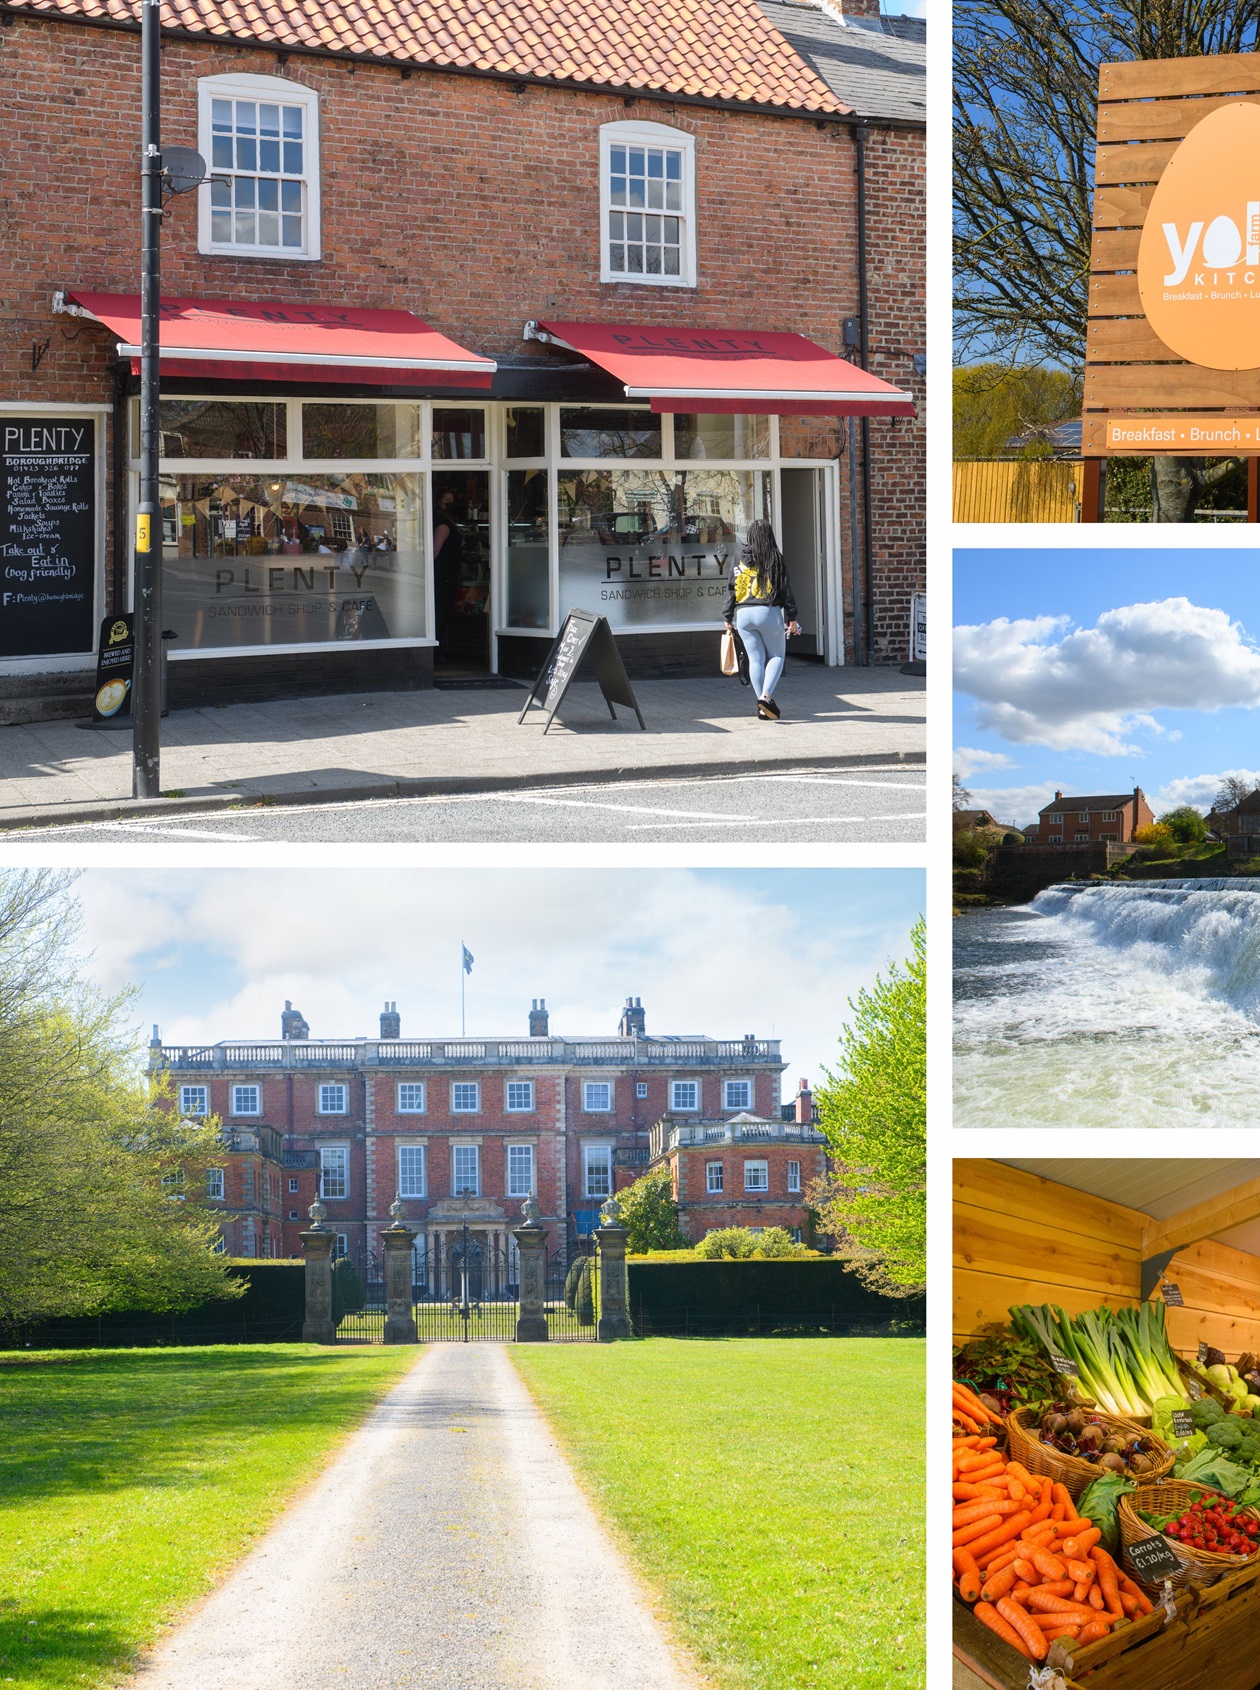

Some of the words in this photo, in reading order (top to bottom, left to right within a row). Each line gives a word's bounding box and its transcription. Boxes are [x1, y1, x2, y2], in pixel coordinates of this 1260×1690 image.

[1248, 214, 1260, 246] farm
[1163, 292, 1202, 300] Breakfast
[1210, 290, 1242, 300] Brunch
[611, 335, 764, 350] PLENTY
[5, 428, 84, 451] PLENTY
[1112, 427, 1176, 442] Breakfast
[1190, 427, 1240, 441] Brunch
[5, 458, 88, 466] BOROUGHBRIDGE
[60, 476, 78, 484] Rolls
[12, 497, 36, 505] Salad
[8, 505, 42, 514] Homemade
[44, 504, 71, 512] Sausage
[72, 502, 89, 512] Rolls
[18, 512, 45, 520] Jackets
[10, 524, 52, 534] Milkshakes
[34, 519, 60, 528] Soups
[139, 528, 146, 540] 5
[0, 543, 24, 556] Take
[27, 543, 45, 555] out
[32, 556, 53, 567] Eat
[56, 554, 72, 567] in
[606, 554, 728, 578] PLENTY
[5, 566, 27, 581] (Dog
[28, 565, 76, 581] friendly)
[216, 565, 368, 594] PLENTY
[600, 588, 660, 601] SANDWICH
[664, 587, 692, 599] SHOP
[696, 586, 704, 597] &
[208, 604, 282, 618] SANDWICH
[288, 602, 322, 614] SHOP
[328, 602, 336, 612] &
[342, 600, 373, 612] CAFE
[1130, 1540, 1162, 1556] Carrots
